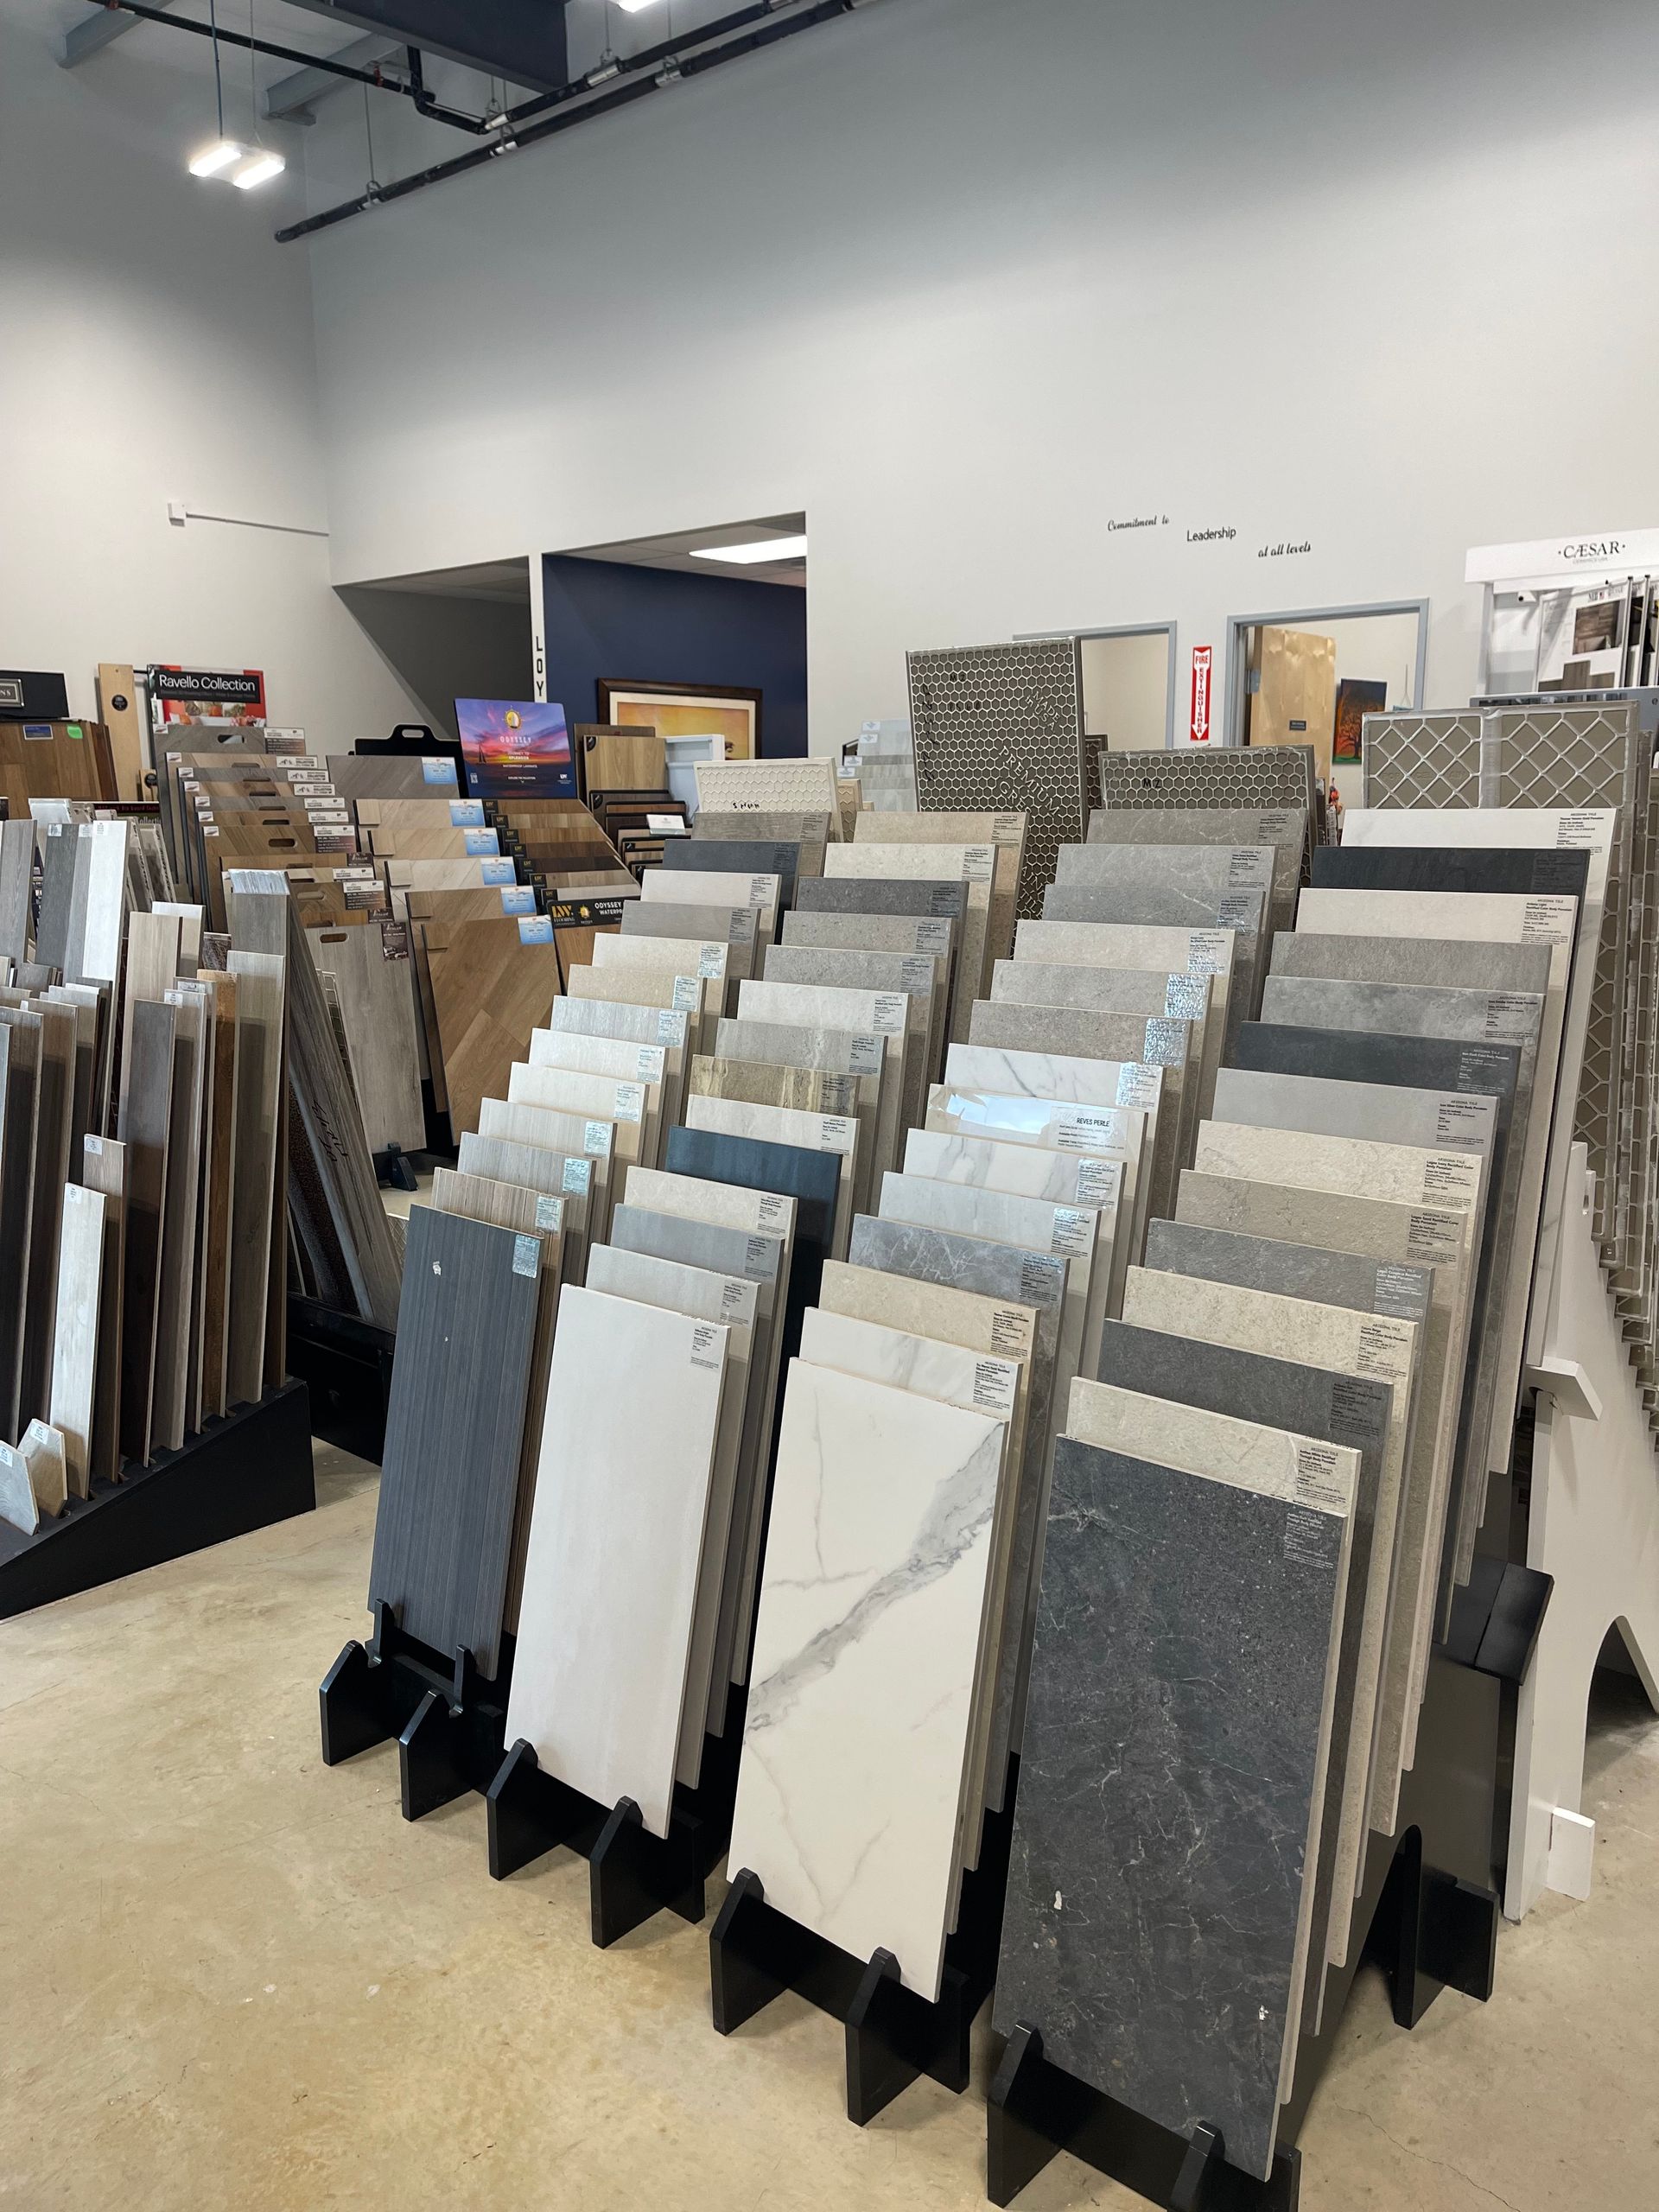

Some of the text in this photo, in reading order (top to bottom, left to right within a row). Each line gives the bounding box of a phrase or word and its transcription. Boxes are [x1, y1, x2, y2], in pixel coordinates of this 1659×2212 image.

[1108, 514, 1169, 531] Commitment to
[1186, 525, 1236, 542] Leadership
[1258, 541, 1311, 557] at all levels
[1195, 655, 1209, 664] FIRE
[159, 674, 256, 691] Ravello Collection
[1033, 690, 1060, 722] MADE
[999, 746, 1060, 815] PREMIUM
[1093, 1119, 1110, 1128] PERLE
